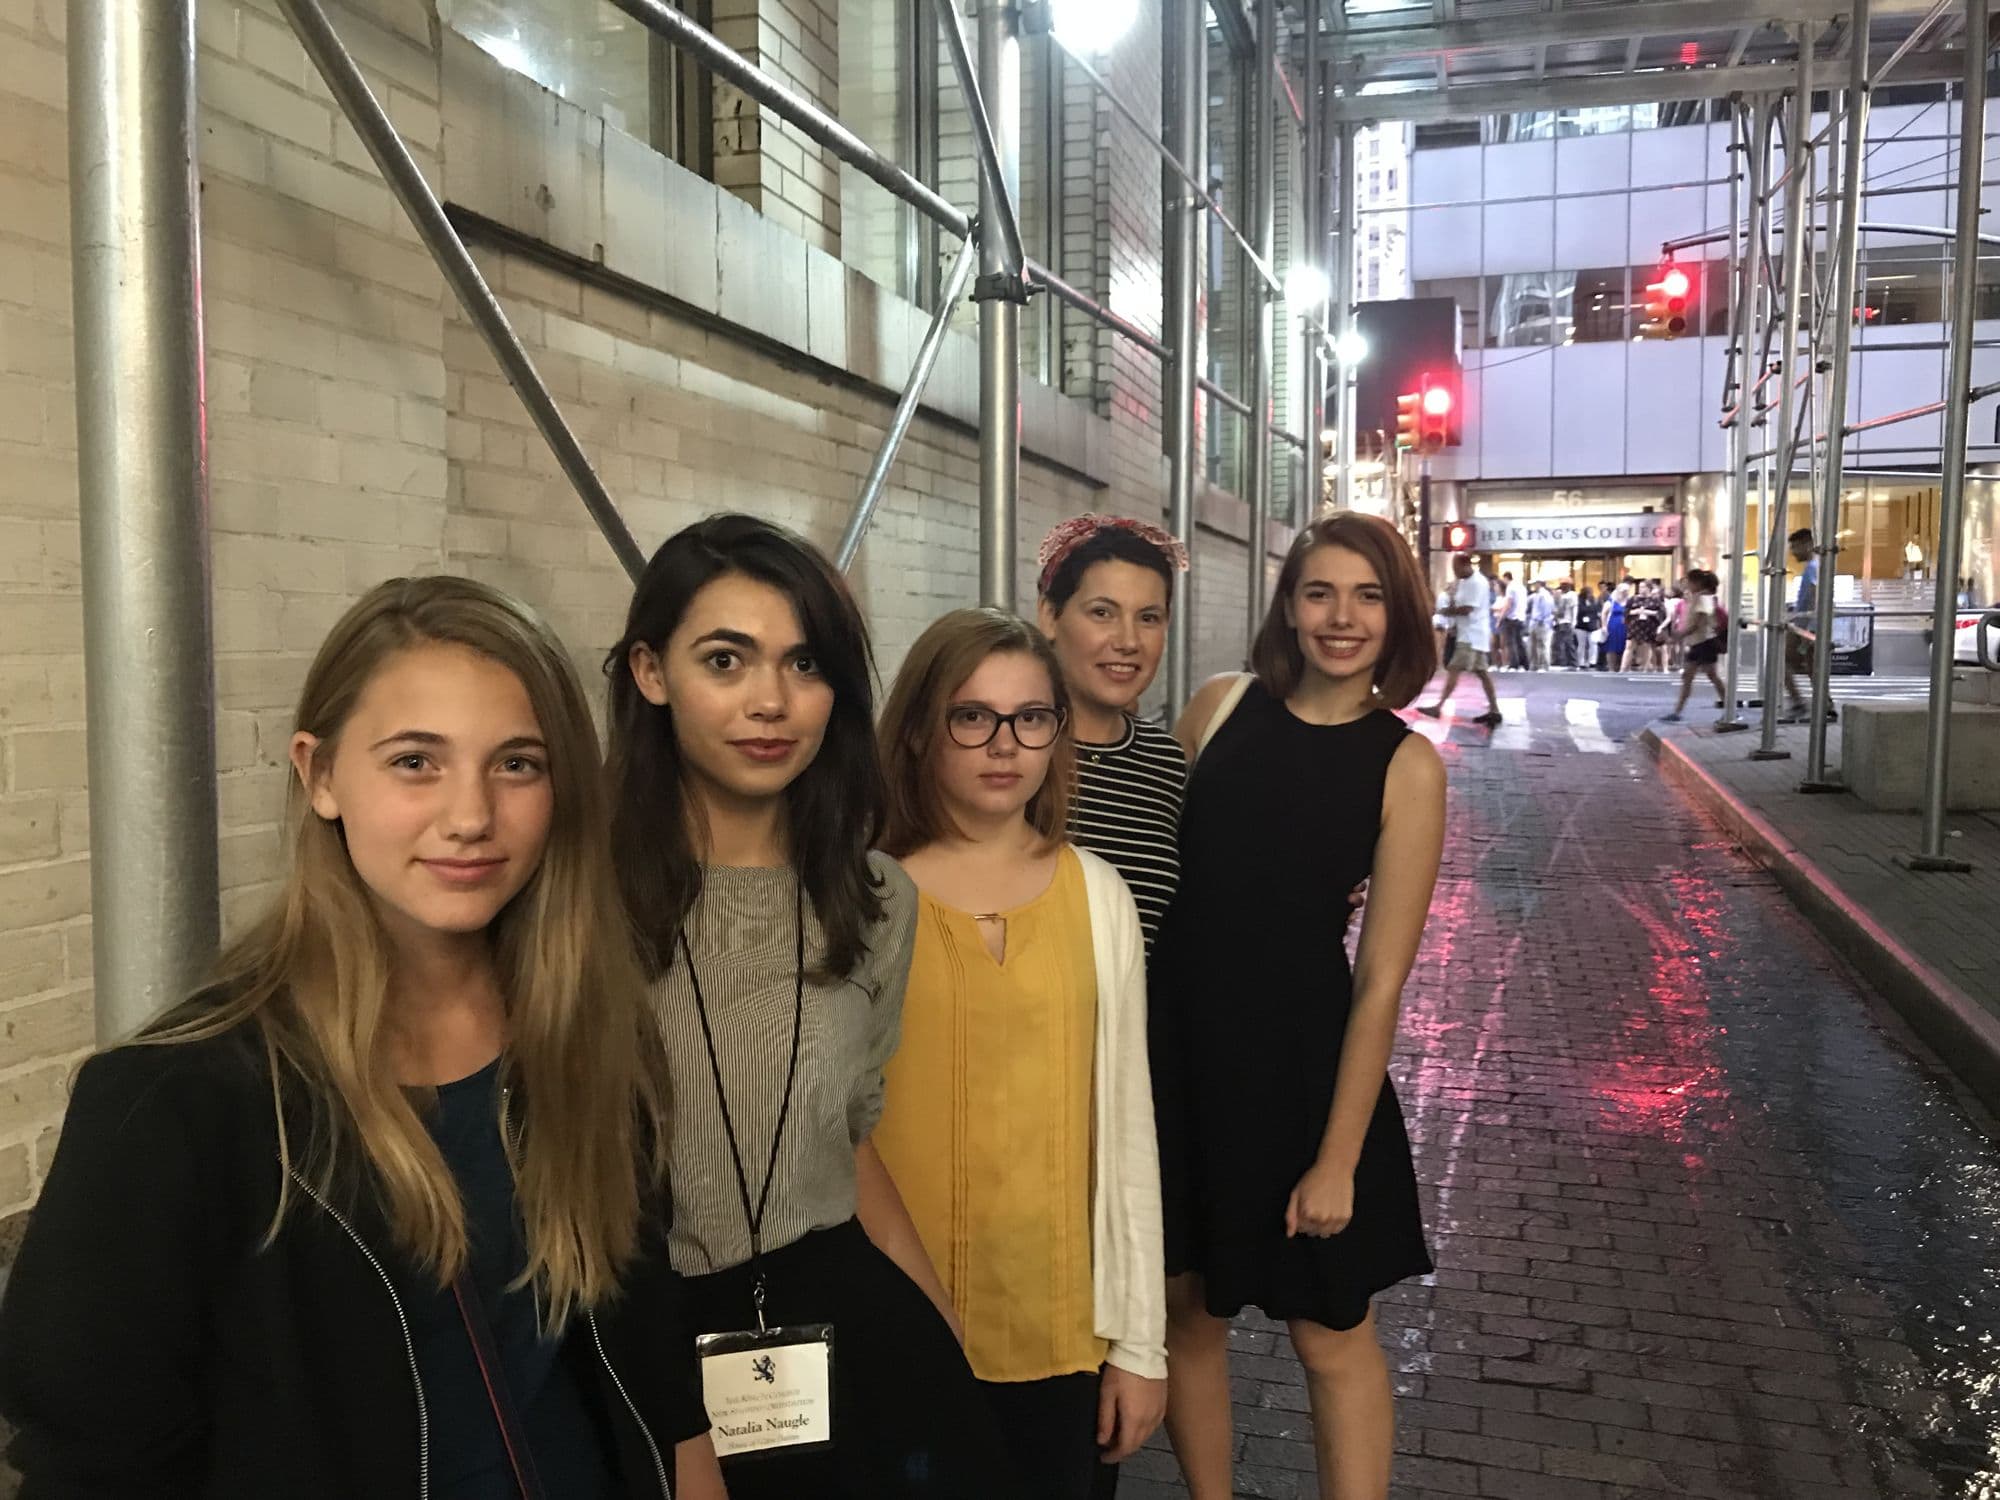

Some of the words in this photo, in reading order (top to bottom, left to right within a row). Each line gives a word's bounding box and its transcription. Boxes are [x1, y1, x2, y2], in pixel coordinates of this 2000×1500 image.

[1552, 490, 1583, 507] 56
[1480, 530, 1505, 541] HE
[1511, 527, 1579, 540] KING'S
[1583, 525, 1676, 540] COLLEGE
[718, 1420, 762, 1438] Natalia
[766, 1413, 810, 1431] Naugle
